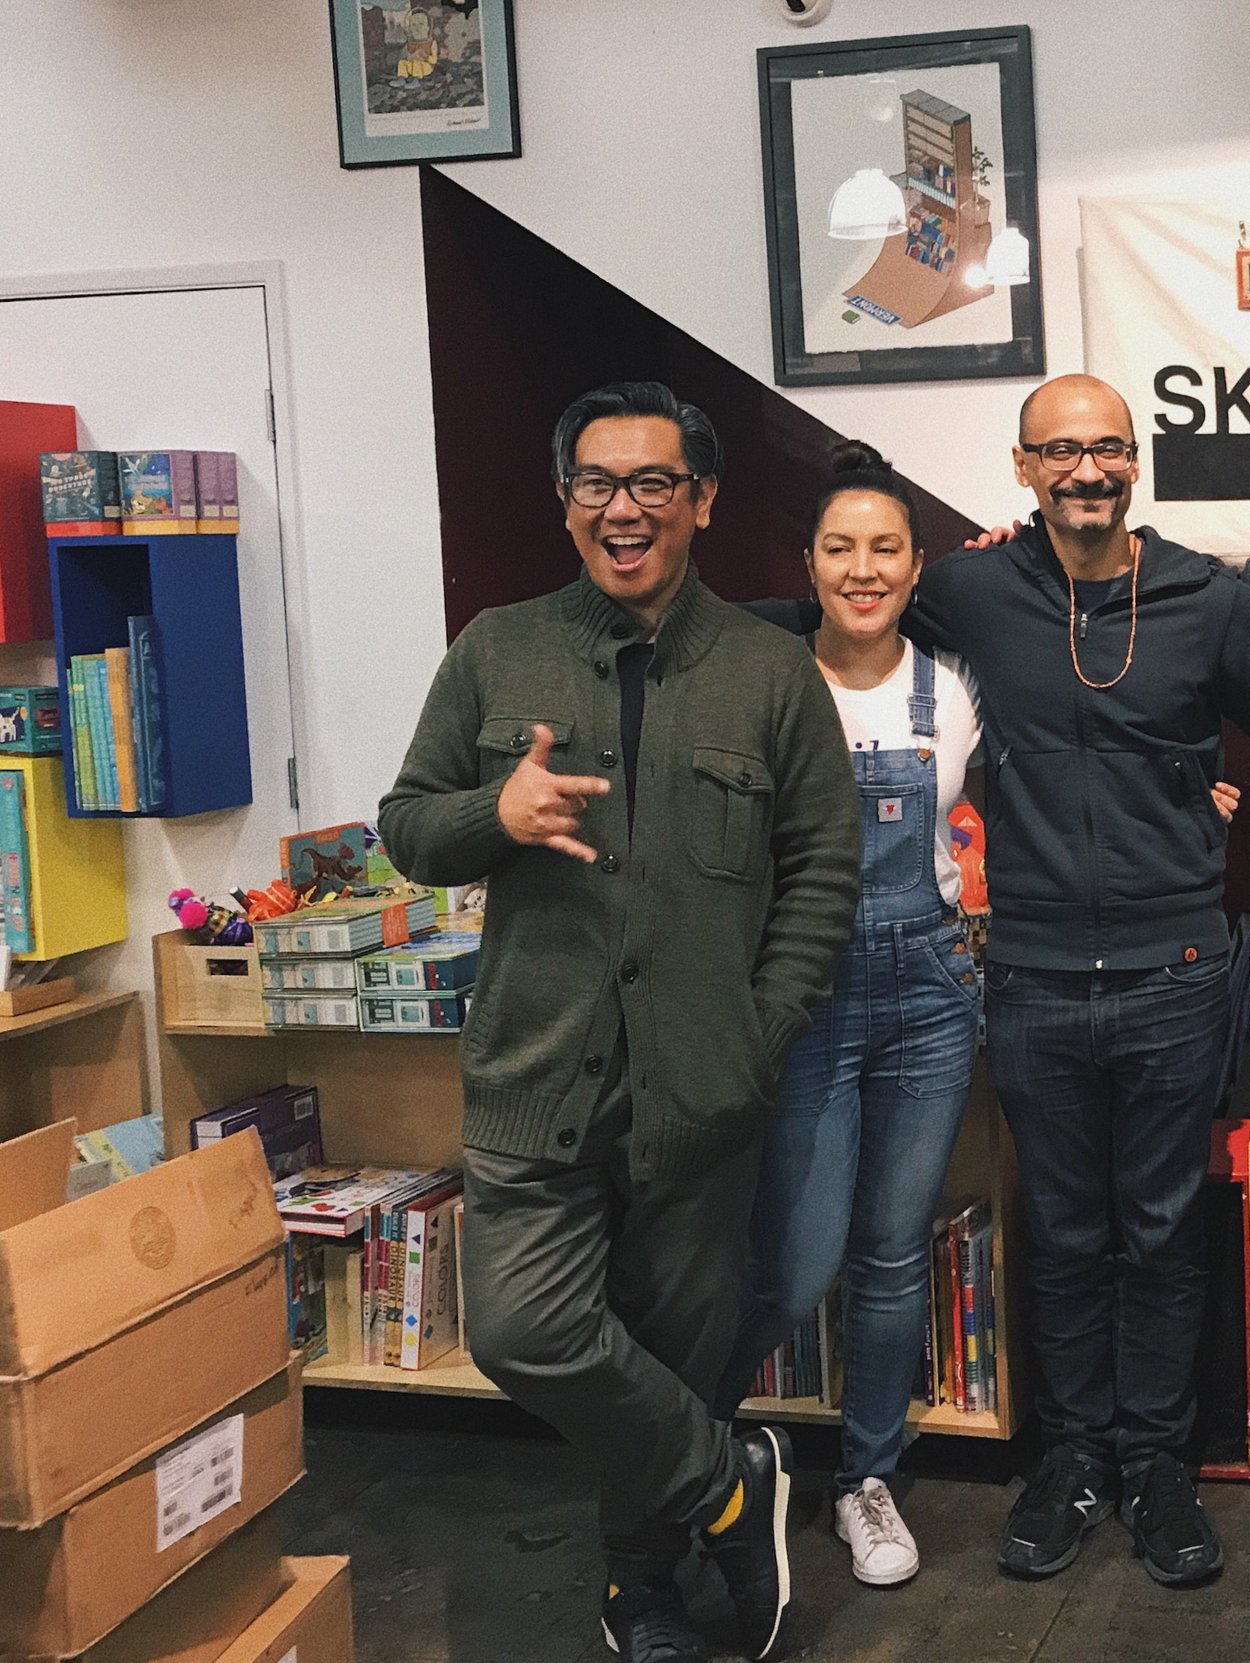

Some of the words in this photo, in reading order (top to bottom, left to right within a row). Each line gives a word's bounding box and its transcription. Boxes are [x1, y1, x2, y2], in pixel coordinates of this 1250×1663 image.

[851, 297, 895, 324] VERMONT
[389, 1246, 397, 1302] DINOSAUR
[398, 1247, 406, 1303] DINOSAUR
